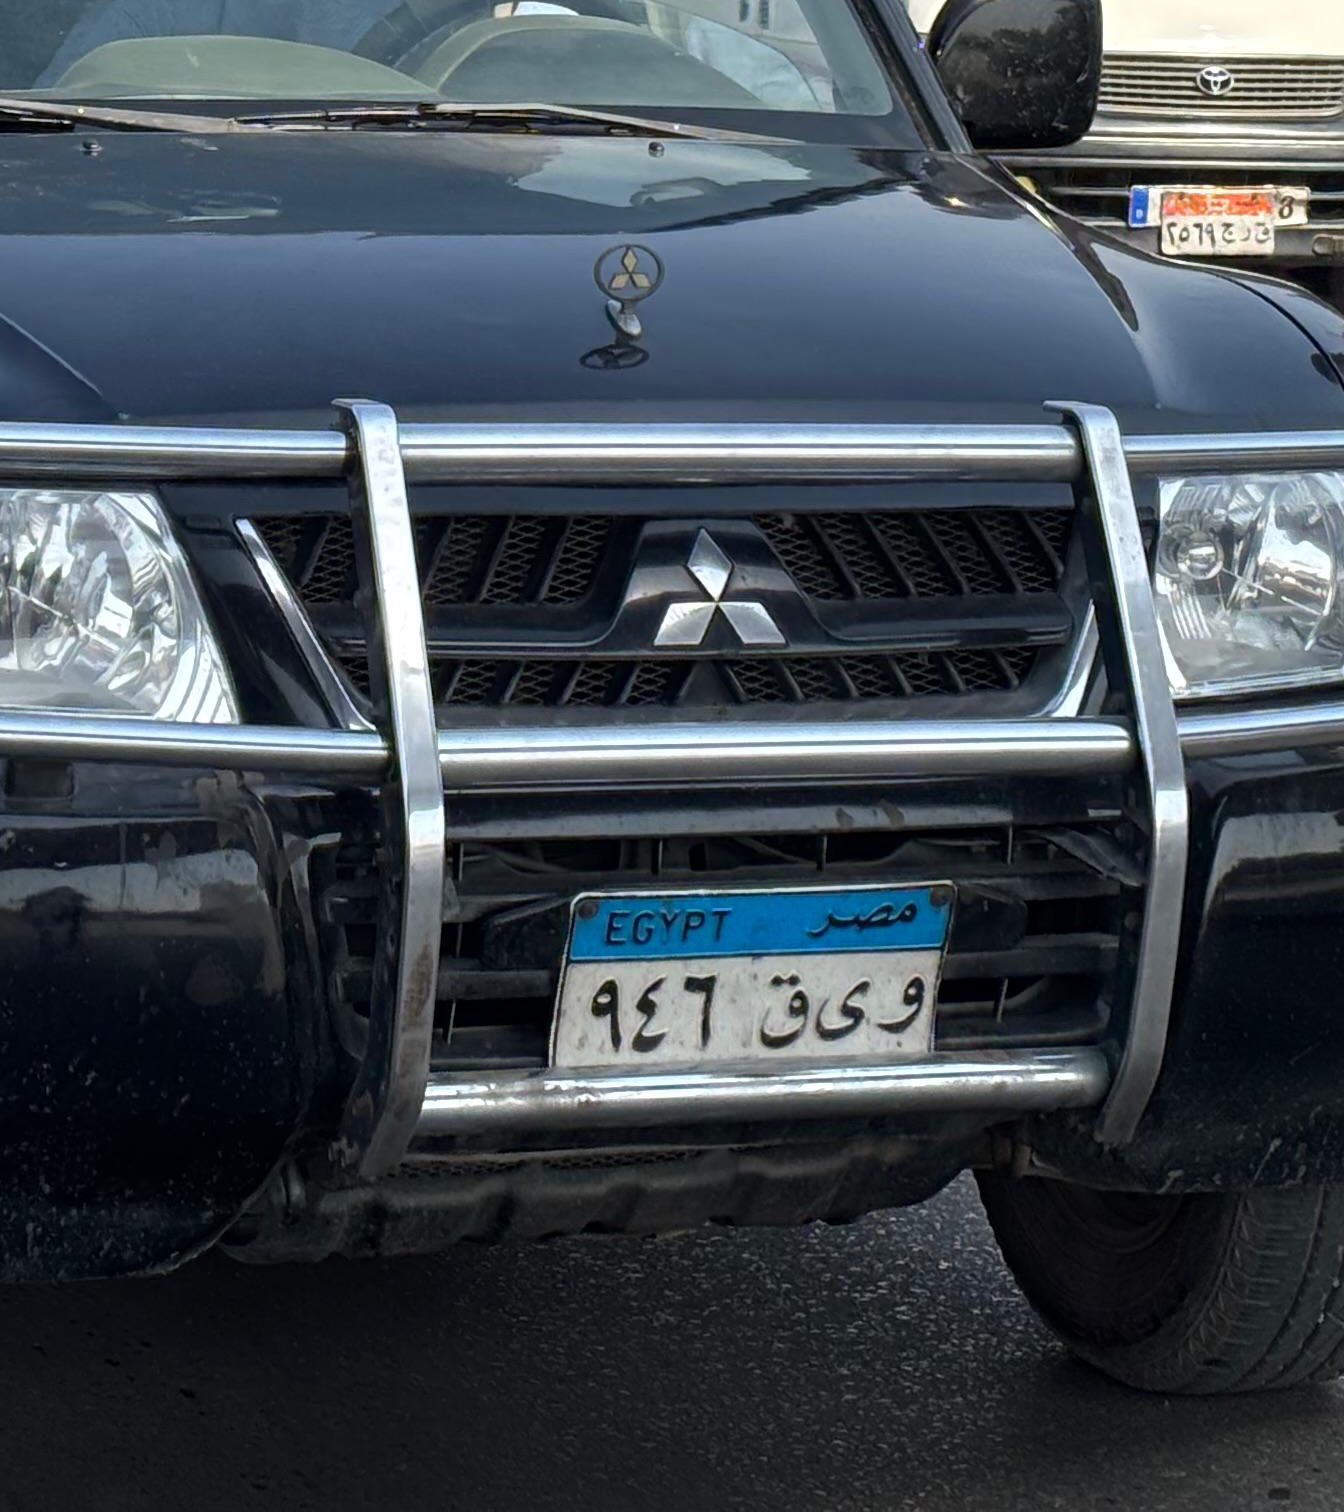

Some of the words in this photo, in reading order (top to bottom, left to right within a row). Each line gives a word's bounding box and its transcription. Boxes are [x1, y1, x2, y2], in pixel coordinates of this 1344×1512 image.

[603, 907, 733, 947] EGYPT
[805, 900, 918, 938] مصر
[590, 972, 718, 1054] ٩٤٦
